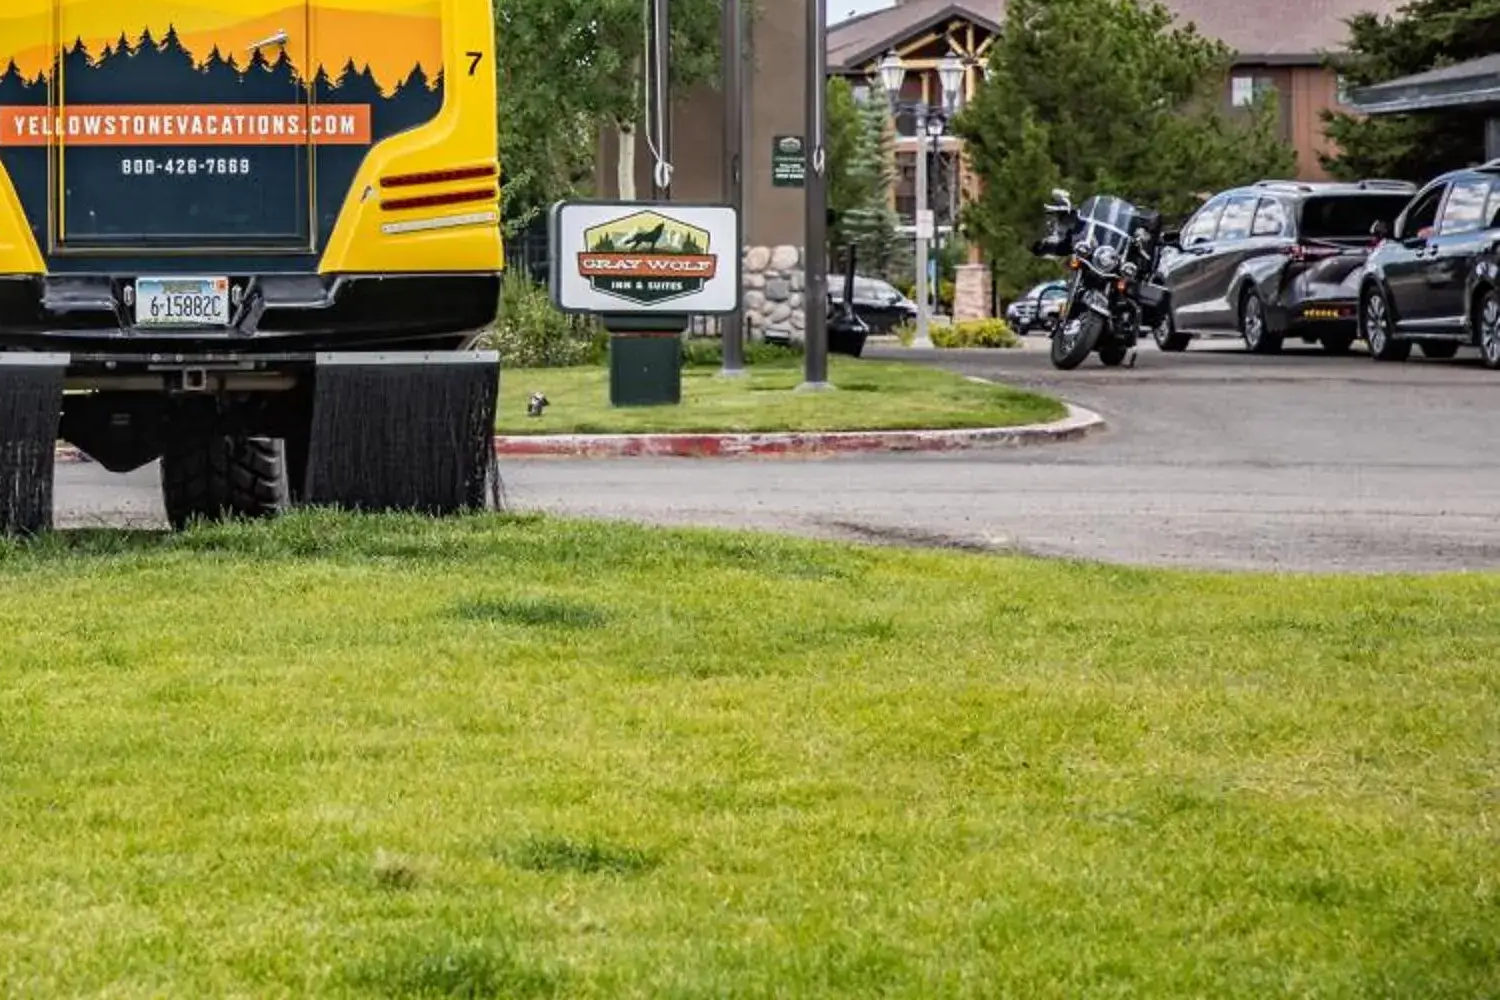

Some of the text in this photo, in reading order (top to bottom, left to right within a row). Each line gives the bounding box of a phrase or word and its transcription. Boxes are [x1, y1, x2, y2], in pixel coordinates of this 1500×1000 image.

[465, 50, 483, 77] 7
[13, 114, 356, 136] YELLOWSTONEVACATIONS.COM
[583, 259, 712, 272] GRAY WOLF
[611, 281, 632, 290] INN
[647, 281, 684, 291] SUITES
[150, 295, 221, 317] 6-15882C
